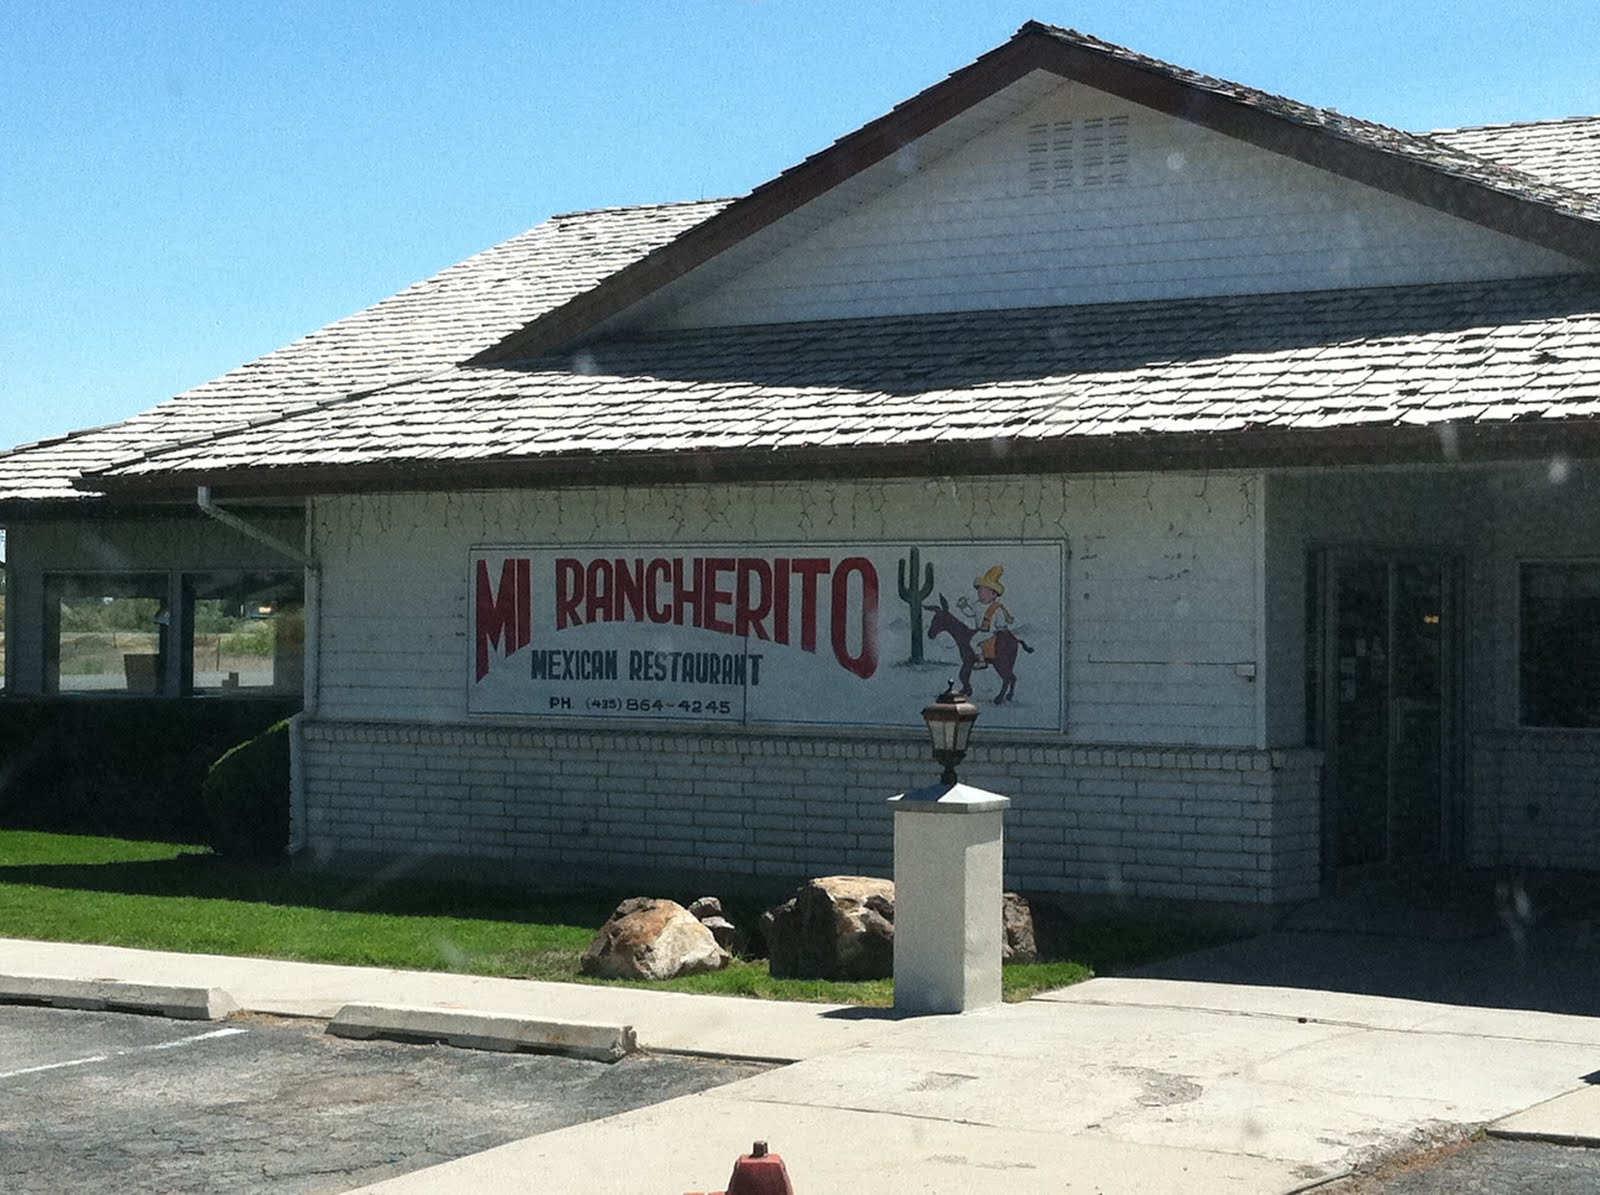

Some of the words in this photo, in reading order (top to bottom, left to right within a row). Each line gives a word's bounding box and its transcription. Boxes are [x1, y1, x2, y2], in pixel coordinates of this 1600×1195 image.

[475, 558, 531, 684] MI
[556, 557, 879, 679] RANCHERITO
[531, 650, 617, 680] MEXICAN
[629, 650, 763, 686] RESTAURANT
[626, 698, 731, 714] 864-4245
